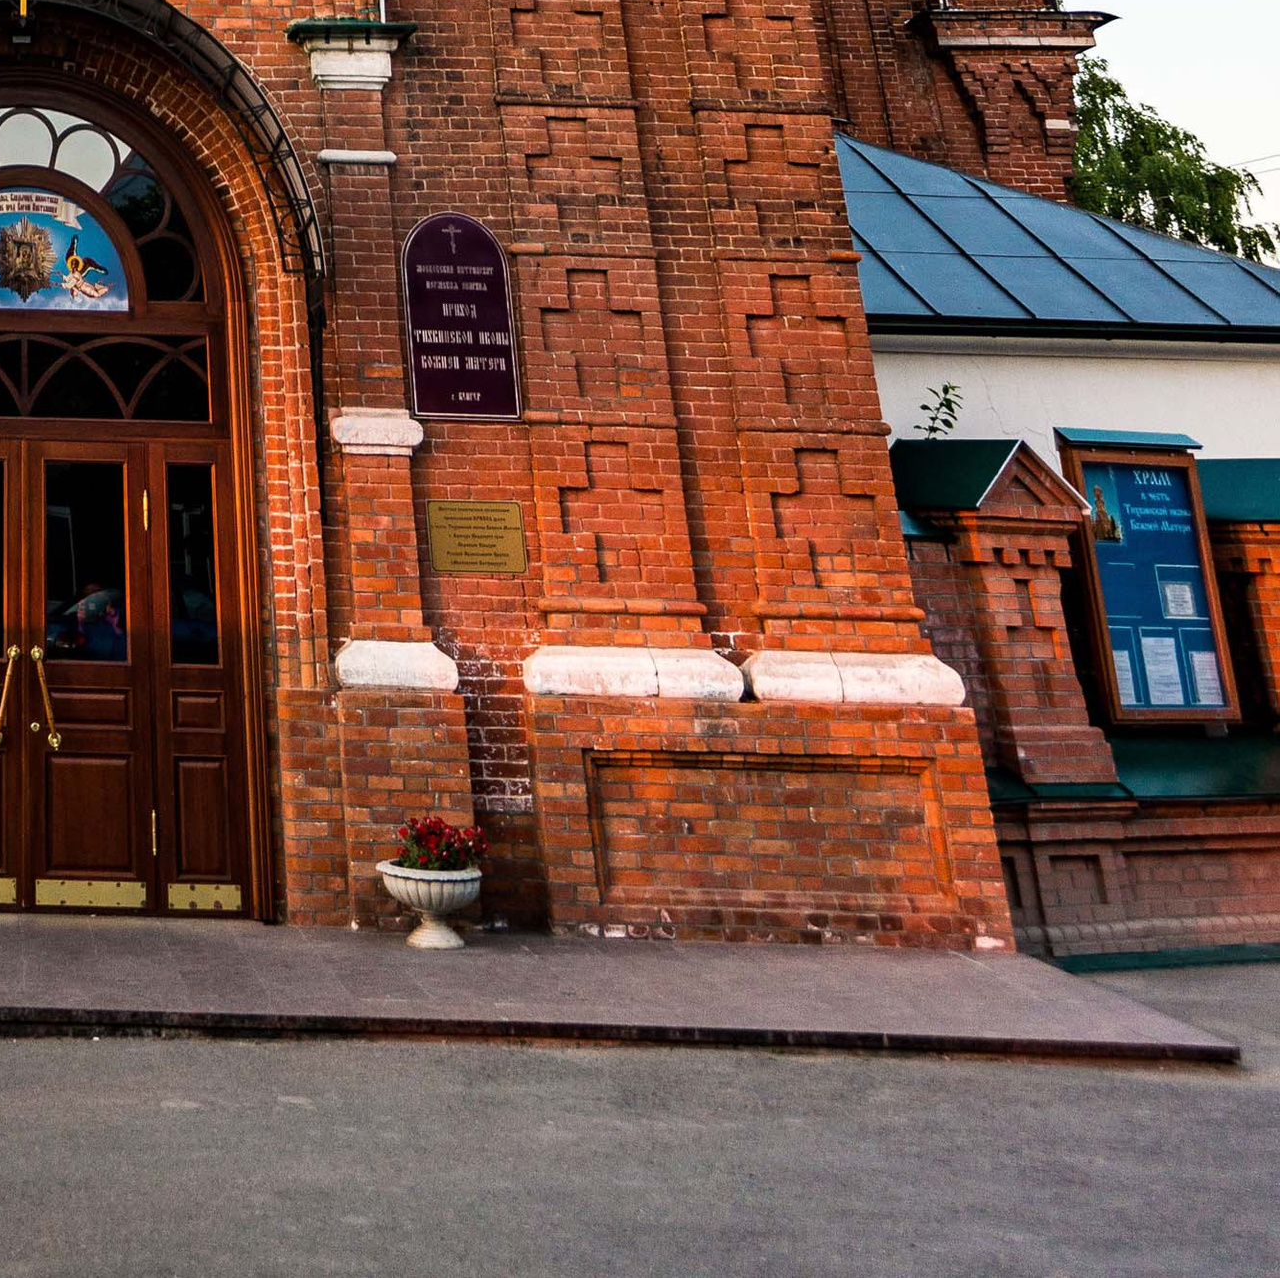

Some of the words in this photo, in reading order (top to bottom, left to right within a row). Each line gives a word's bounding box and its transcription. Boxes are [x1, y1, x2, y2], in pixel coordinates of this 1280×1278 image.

[442, 303, 477, 319] ПРИХОД
[478, 330, 510, 346] ИКОНЫ
[464, 356, 506, 371] МАТЕРИ
[1132, 470, 1172, 487] ХРАМ
